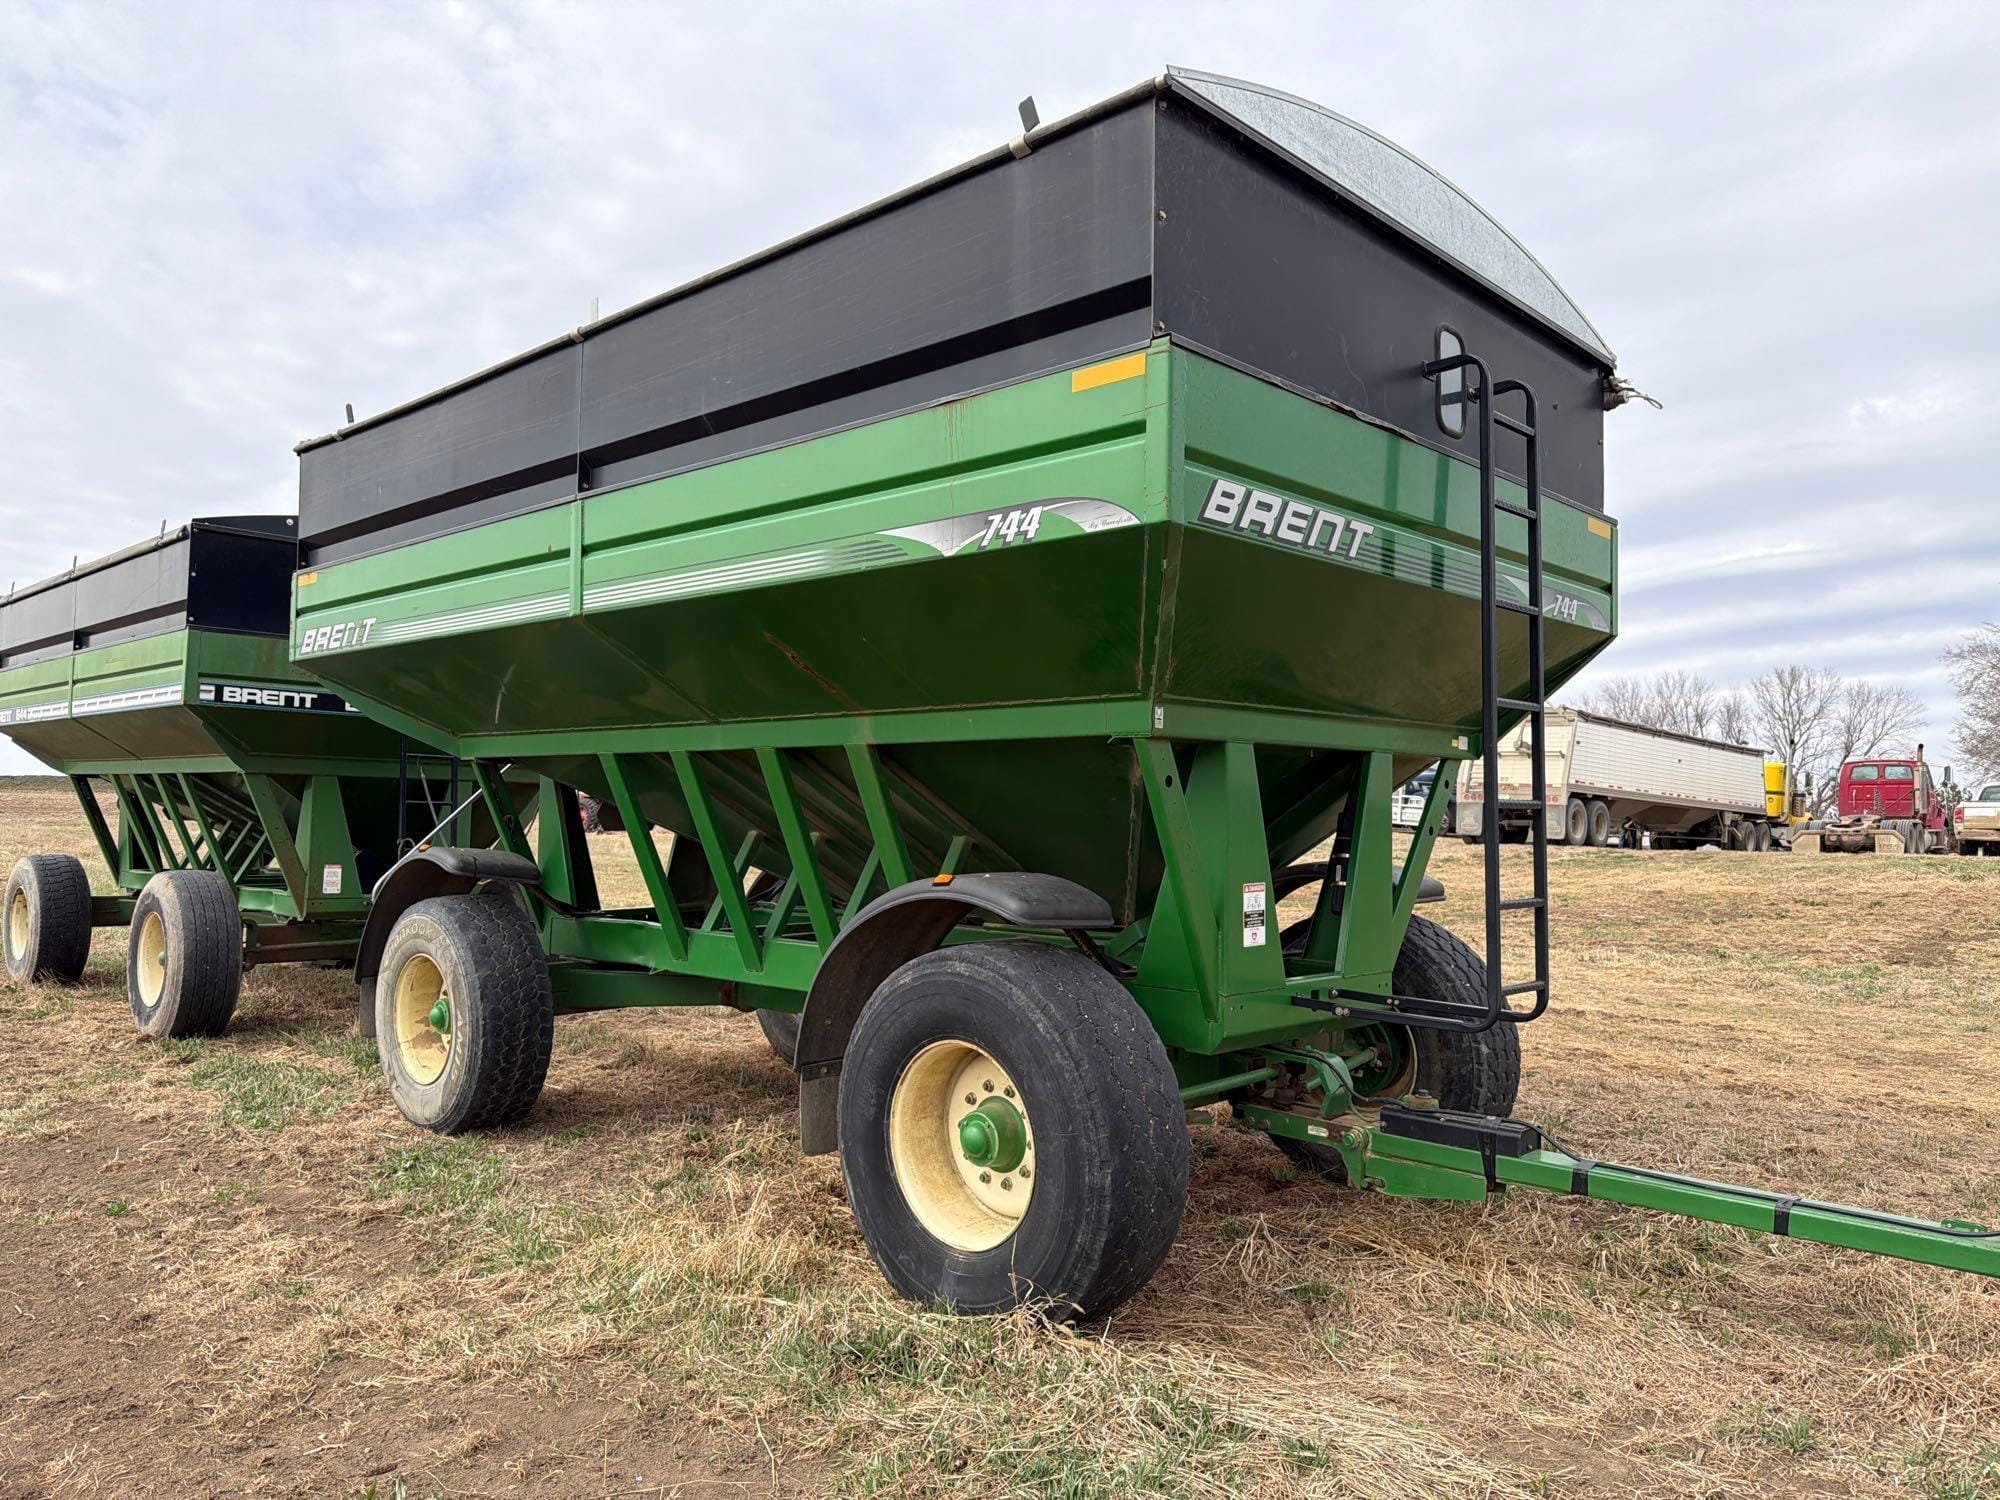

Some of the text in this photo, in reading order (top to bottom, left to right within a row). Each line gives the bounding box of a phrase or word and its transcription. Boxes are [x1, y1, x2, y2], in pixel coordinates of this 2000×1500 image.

[978, 506, 1044, 550] 744
[1199, 478, 1375, 560] BRENT
[1553, 594, 1579, 621] 744
[300, 617, 377, 655] BRENT
[222, 686, 318, 709] BRENT
